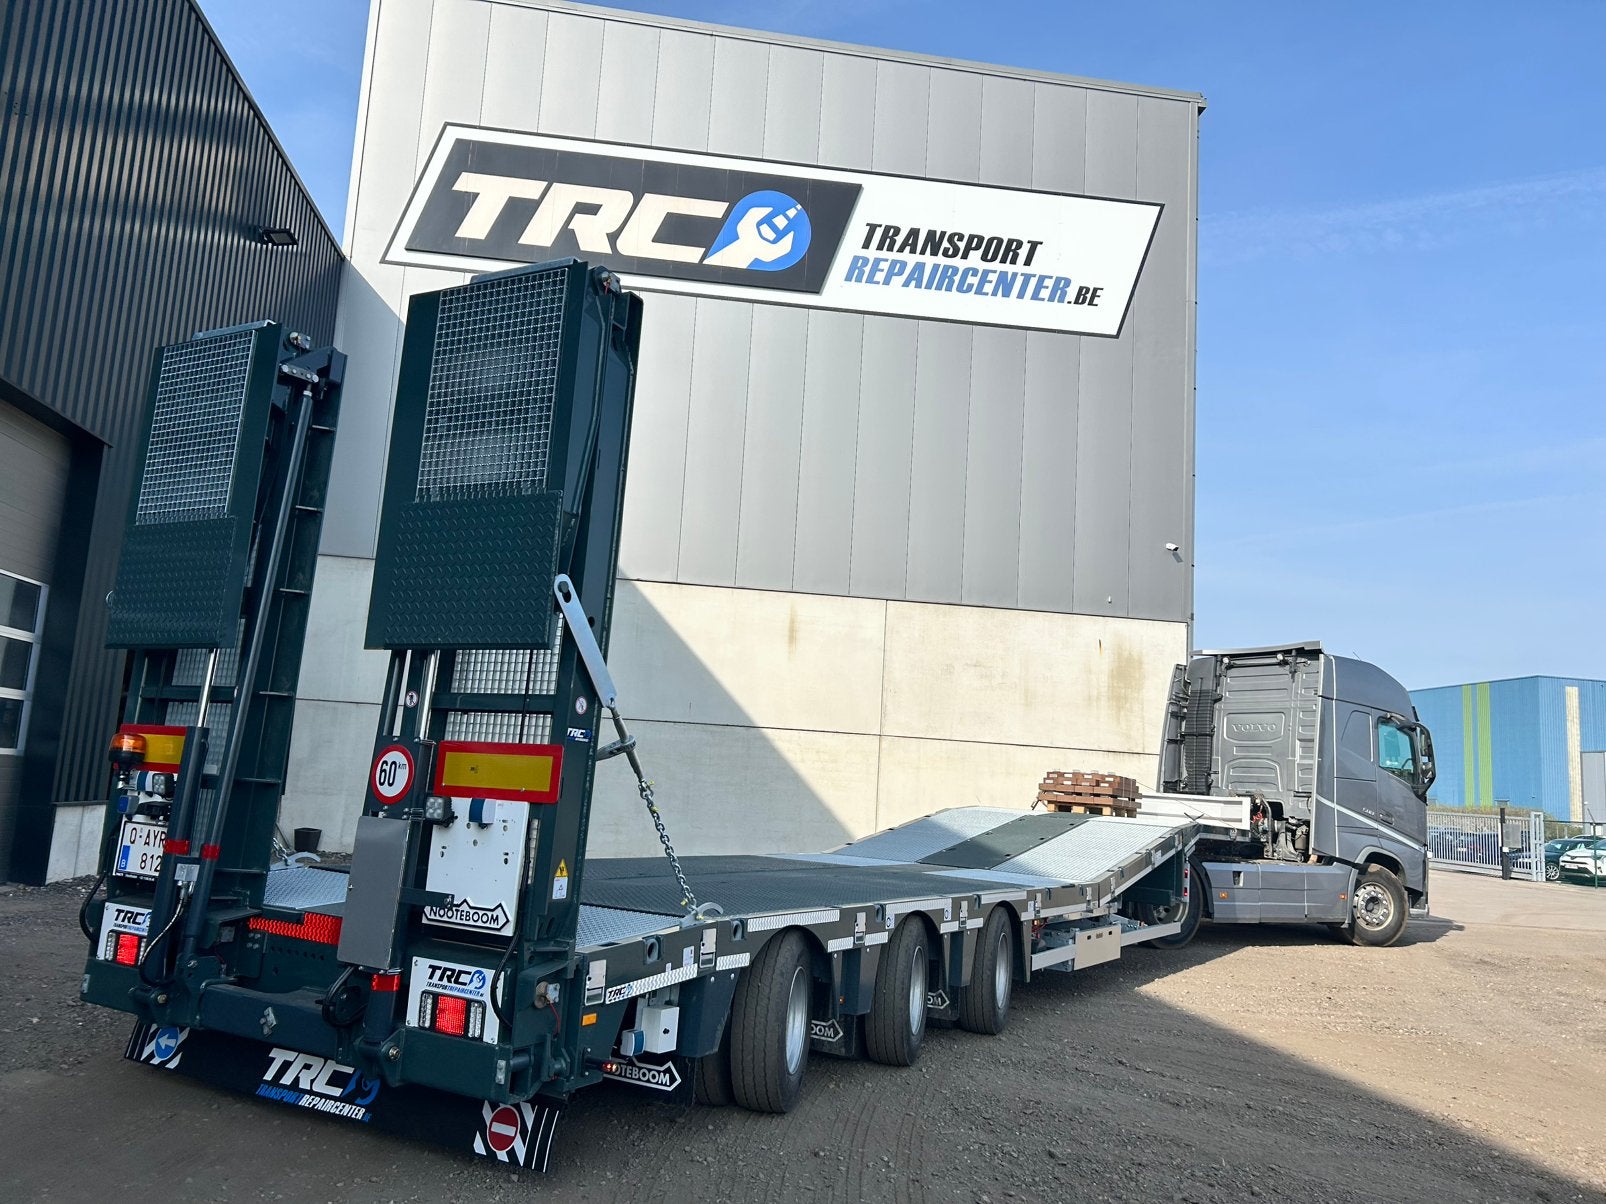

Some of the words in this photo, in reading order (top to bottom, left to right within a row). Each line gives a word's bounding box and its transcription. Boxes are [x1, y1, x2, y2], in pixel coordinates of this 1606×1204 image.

[451, 172, 730, 264] TRC
[861, 222, 1043, 267] TRANSPORT
[567, 727, 586, 738] TRC
[1231, 723, 1276, 732] VOLVO
[378, 760, 397, 787] 60
[398, 762, 407, 770] km
[140, 853, 162, 872] 812
[115, 908, 146, 925] TRC
[429, 906, 499, 926] NOOTEBOOM
[428, 964, 472, 987] TRC
[262, 1047, 355, 1097] TRC
